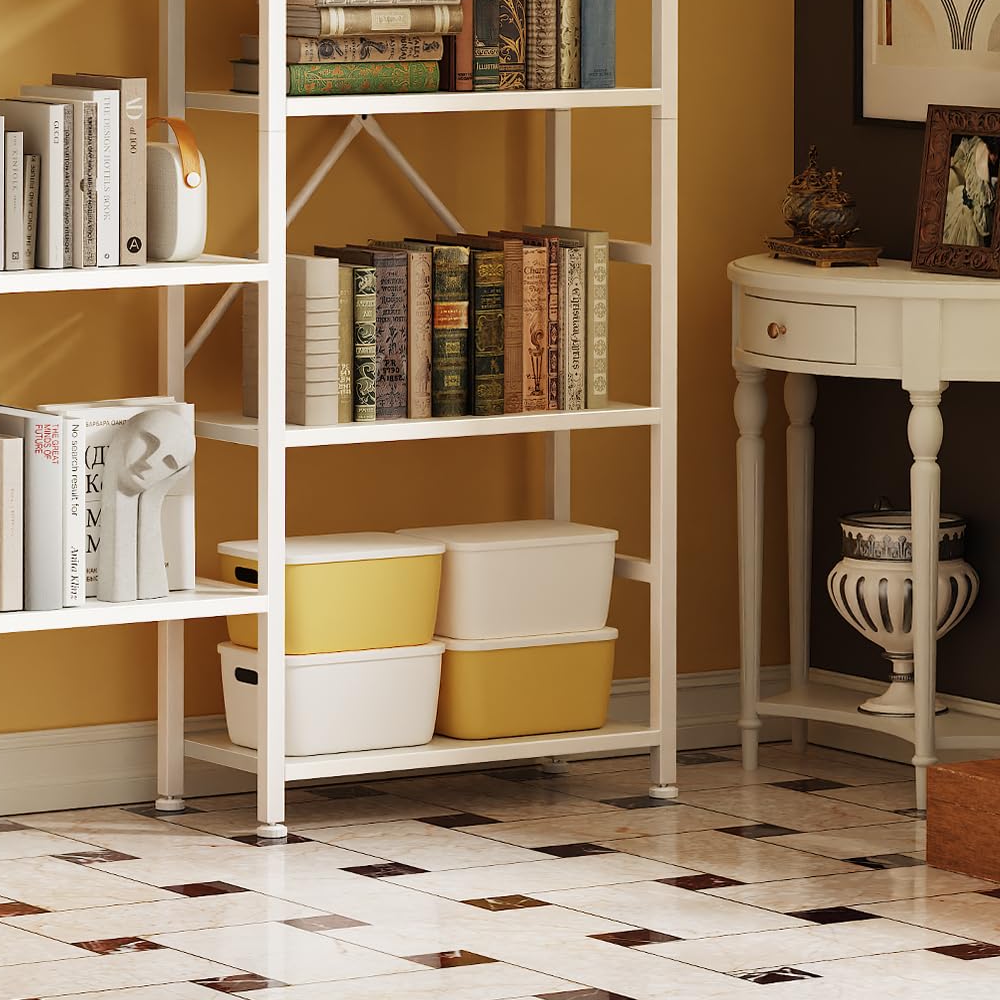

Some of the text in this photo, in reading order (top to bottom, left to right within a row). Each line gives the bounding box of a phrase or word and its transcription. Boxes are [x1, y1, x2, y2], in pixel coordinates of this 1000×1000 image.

[103, 96, 111, 221] THE DESIGN HOTELS BOOK
[35, 424, 43, 454] FUTURE
[43, 424, 51, 448] MINDS
[51, 424, 59, 464] THE GREAT
[71, 424, 80, 517] No search result for
